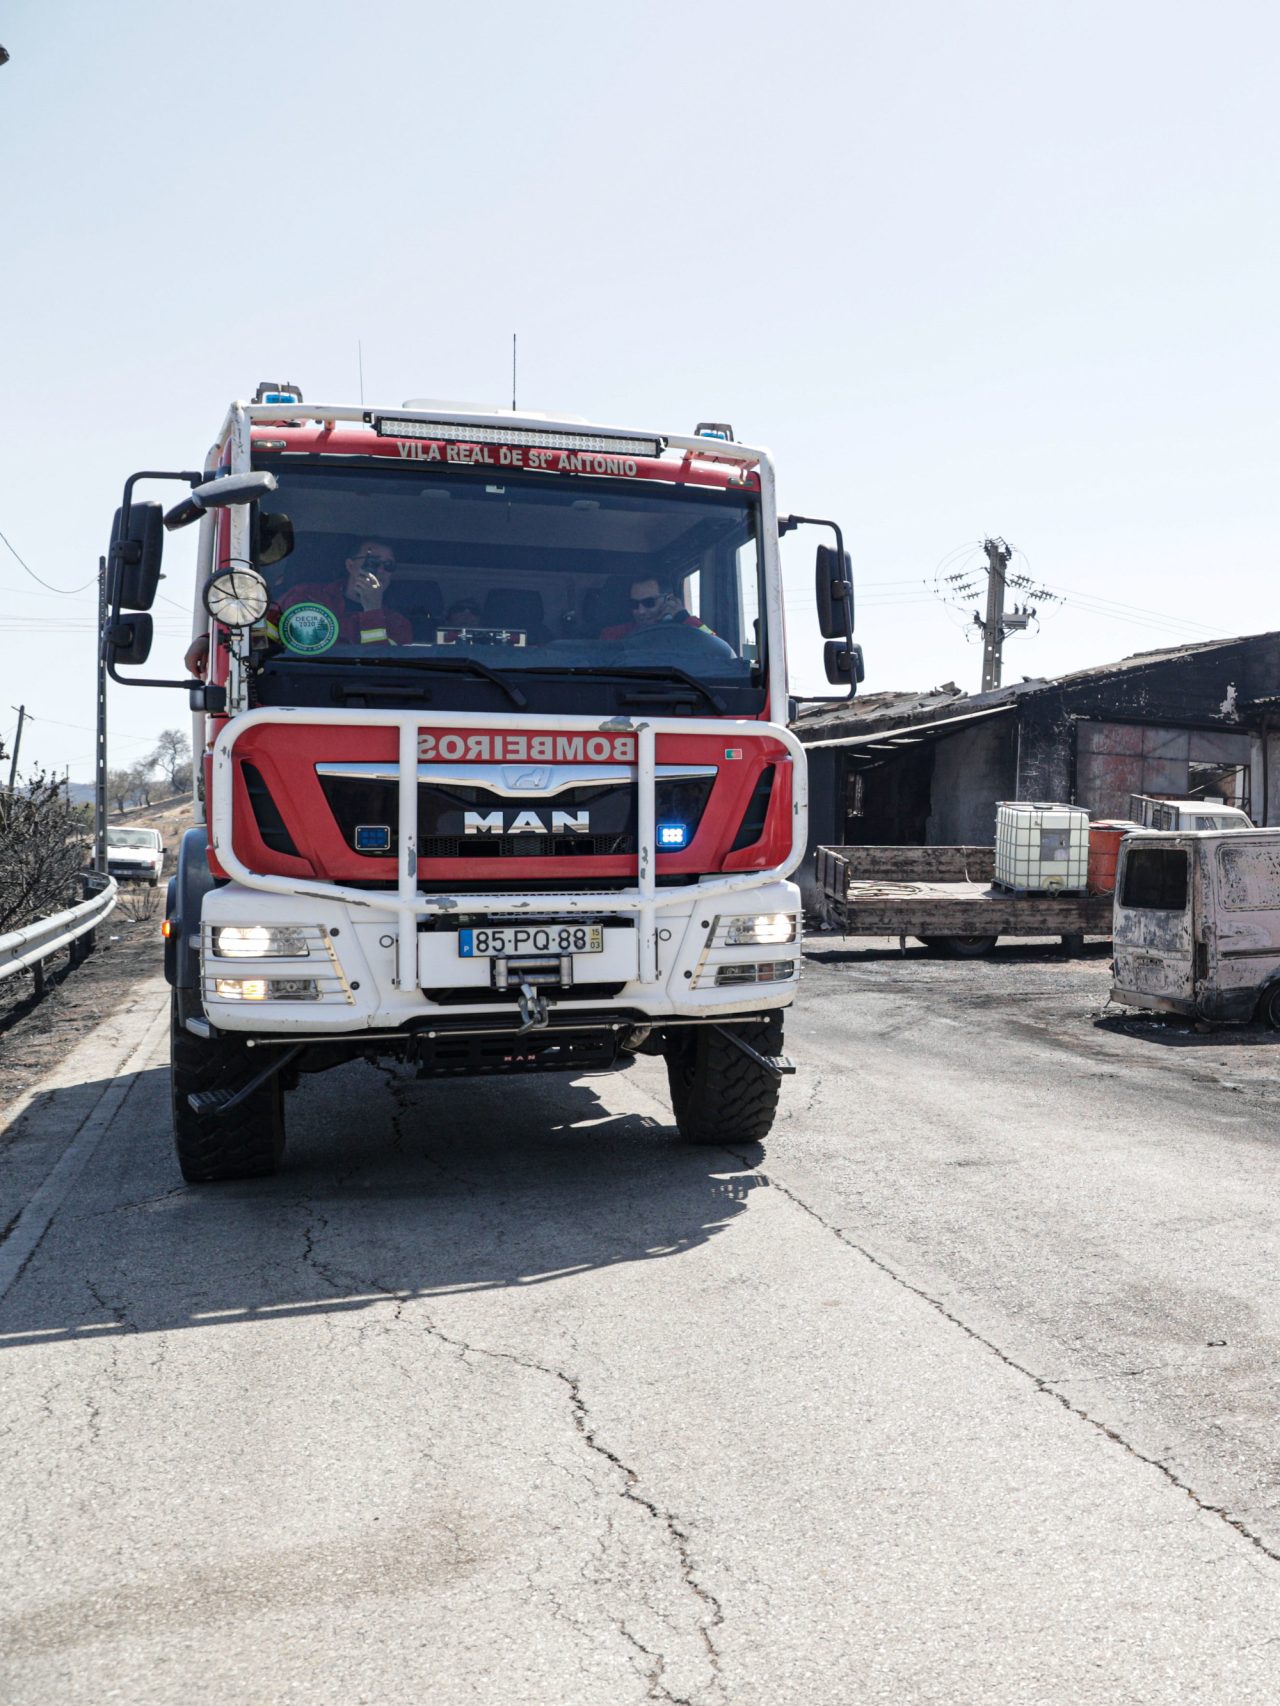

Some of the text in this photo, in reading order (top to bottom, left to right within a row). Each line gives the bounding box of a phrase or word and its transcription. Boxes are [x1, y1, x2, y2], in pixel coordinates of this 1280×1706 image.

[396, 441, 441, 461] VILA
[446, 444, 495, 464] REAL
[500, 448, 523, 466] DE
[558, 455, 638, 477] ANTÓNIO
[463, 810, 590, 834] MAN
[591, 928, 600, 937] 15
[590, 941, 600, 949] 03
